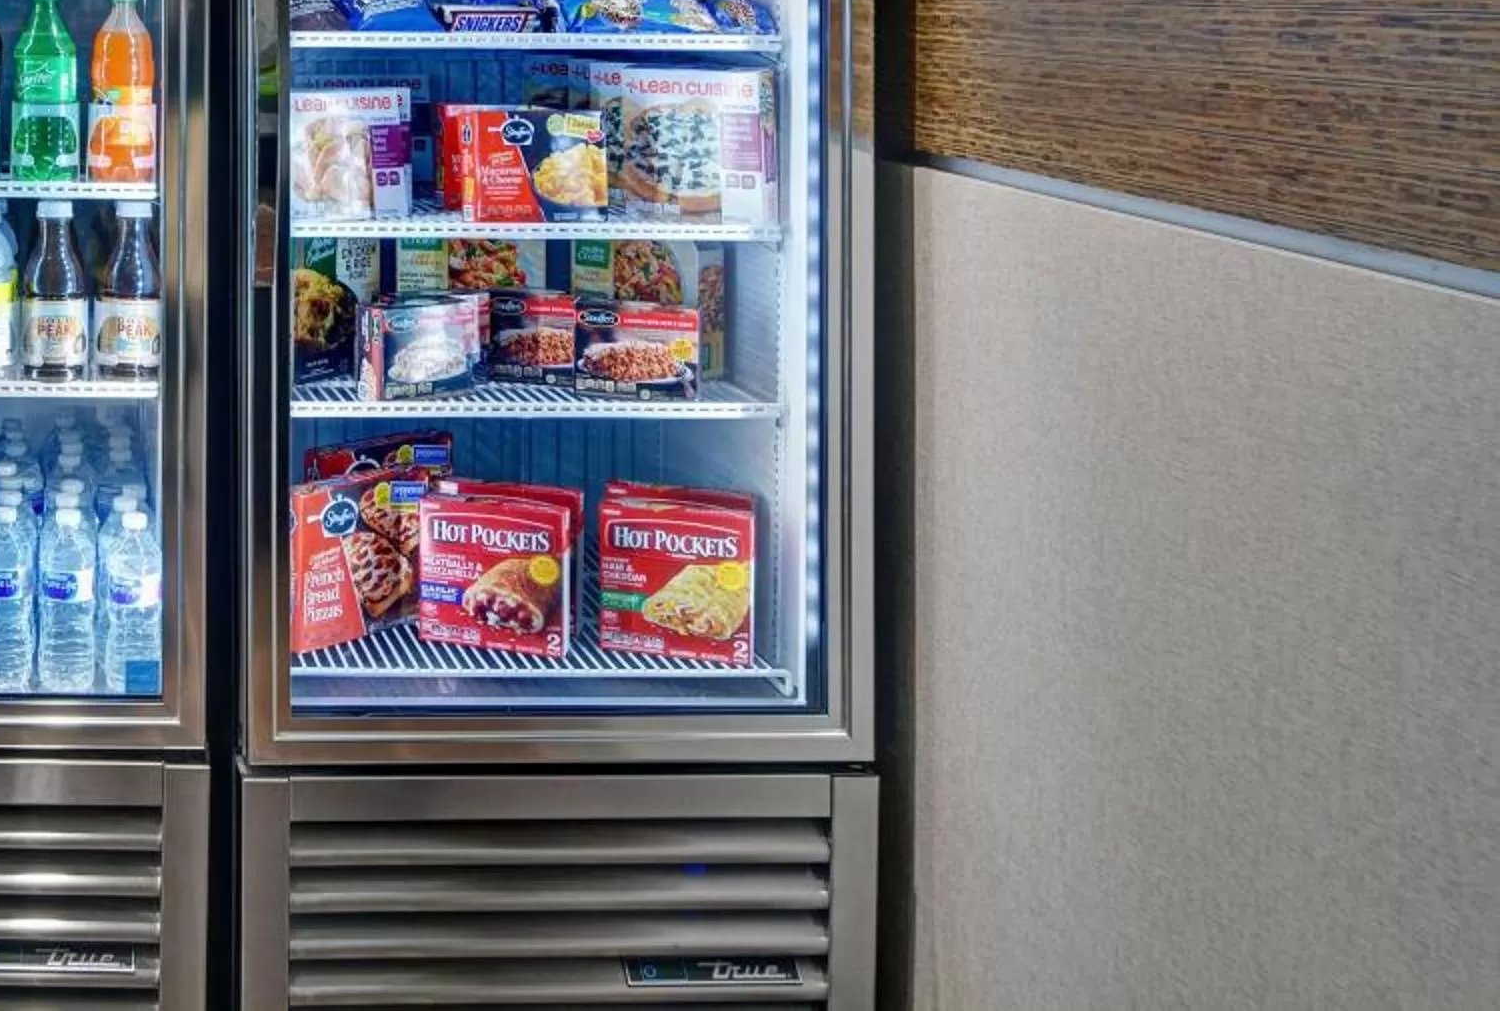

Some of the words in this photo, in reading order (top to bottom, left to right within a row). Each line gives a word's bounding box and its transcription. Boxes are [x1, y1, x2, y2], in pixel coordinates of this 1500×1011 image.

[454, 13, 522, 31] SNICKERS
[432, 519, 469, 543] HOT
[471, 524, 549, 553] POCKETS
[613, 525, 653, 550] HOT
[654, 529, 739, 558] POCKETS
